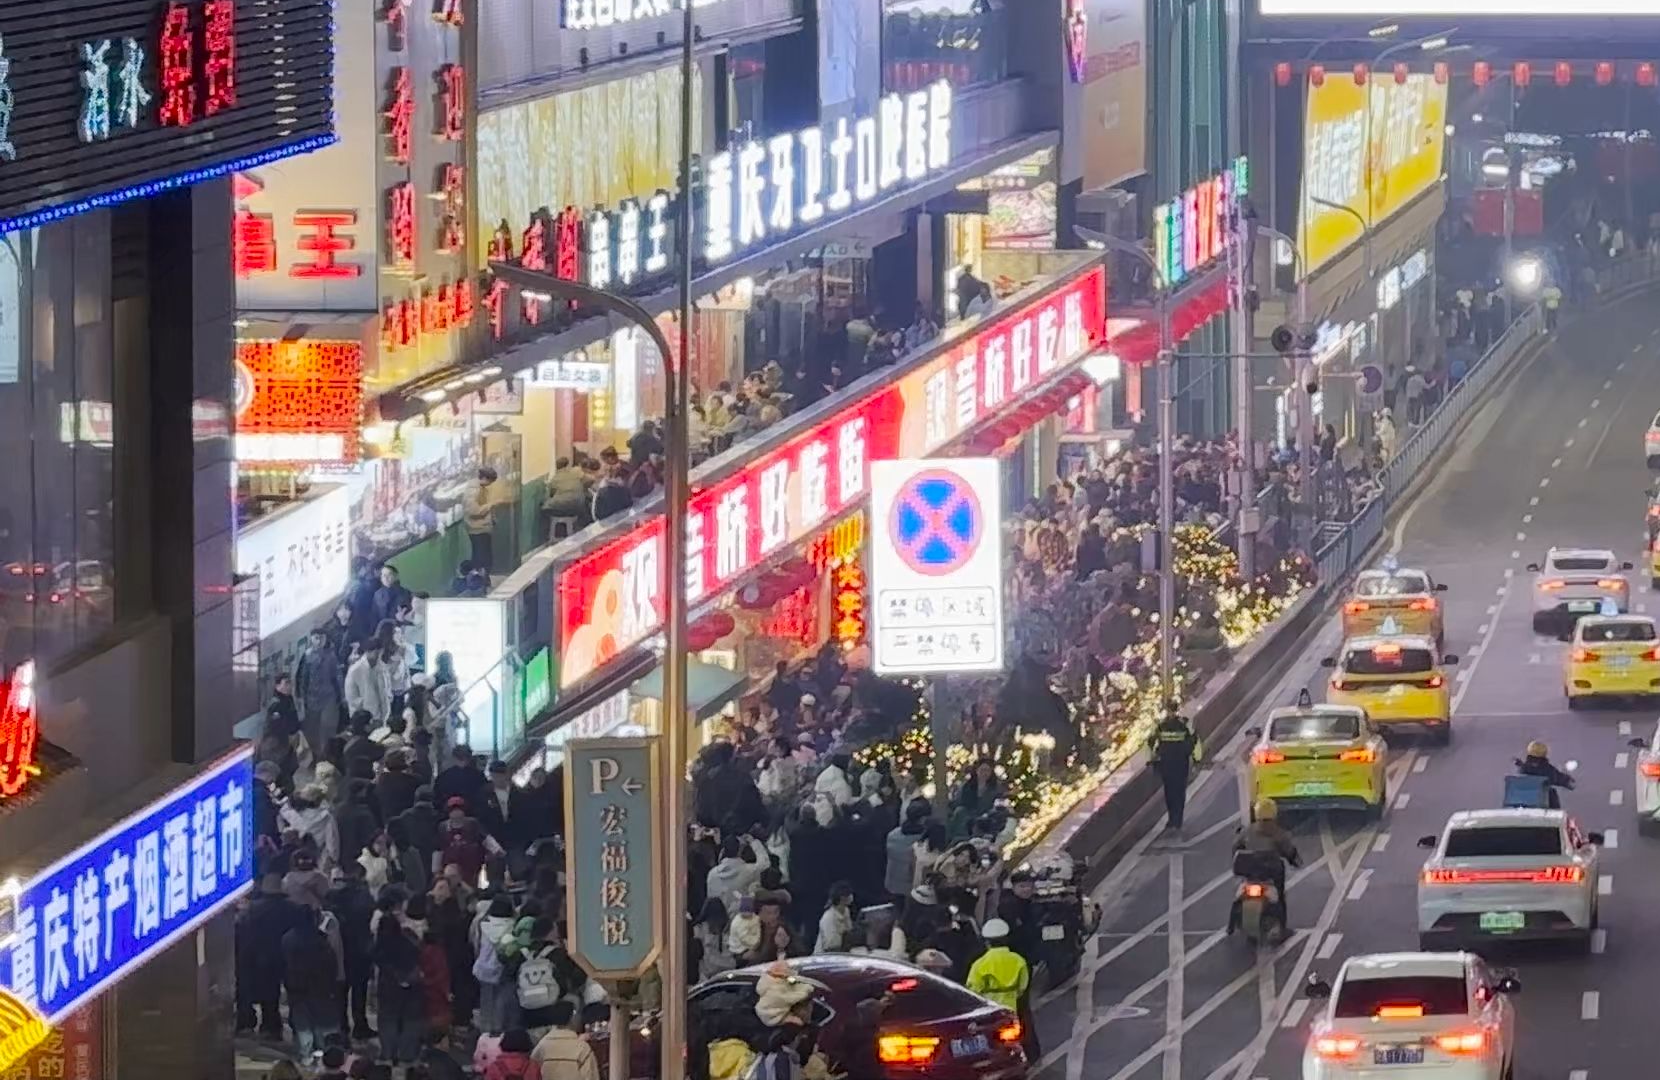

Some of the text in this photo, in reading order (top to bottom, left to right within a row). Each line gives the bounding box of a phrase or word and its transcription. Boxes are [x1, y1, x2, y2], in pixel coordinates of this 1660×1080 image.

[924, 290, 1083, 451] 观音桥好吃街
[589, 758, 619, 795] P
[10, 779, 245, 1007] 重庆特产烟酒超市
